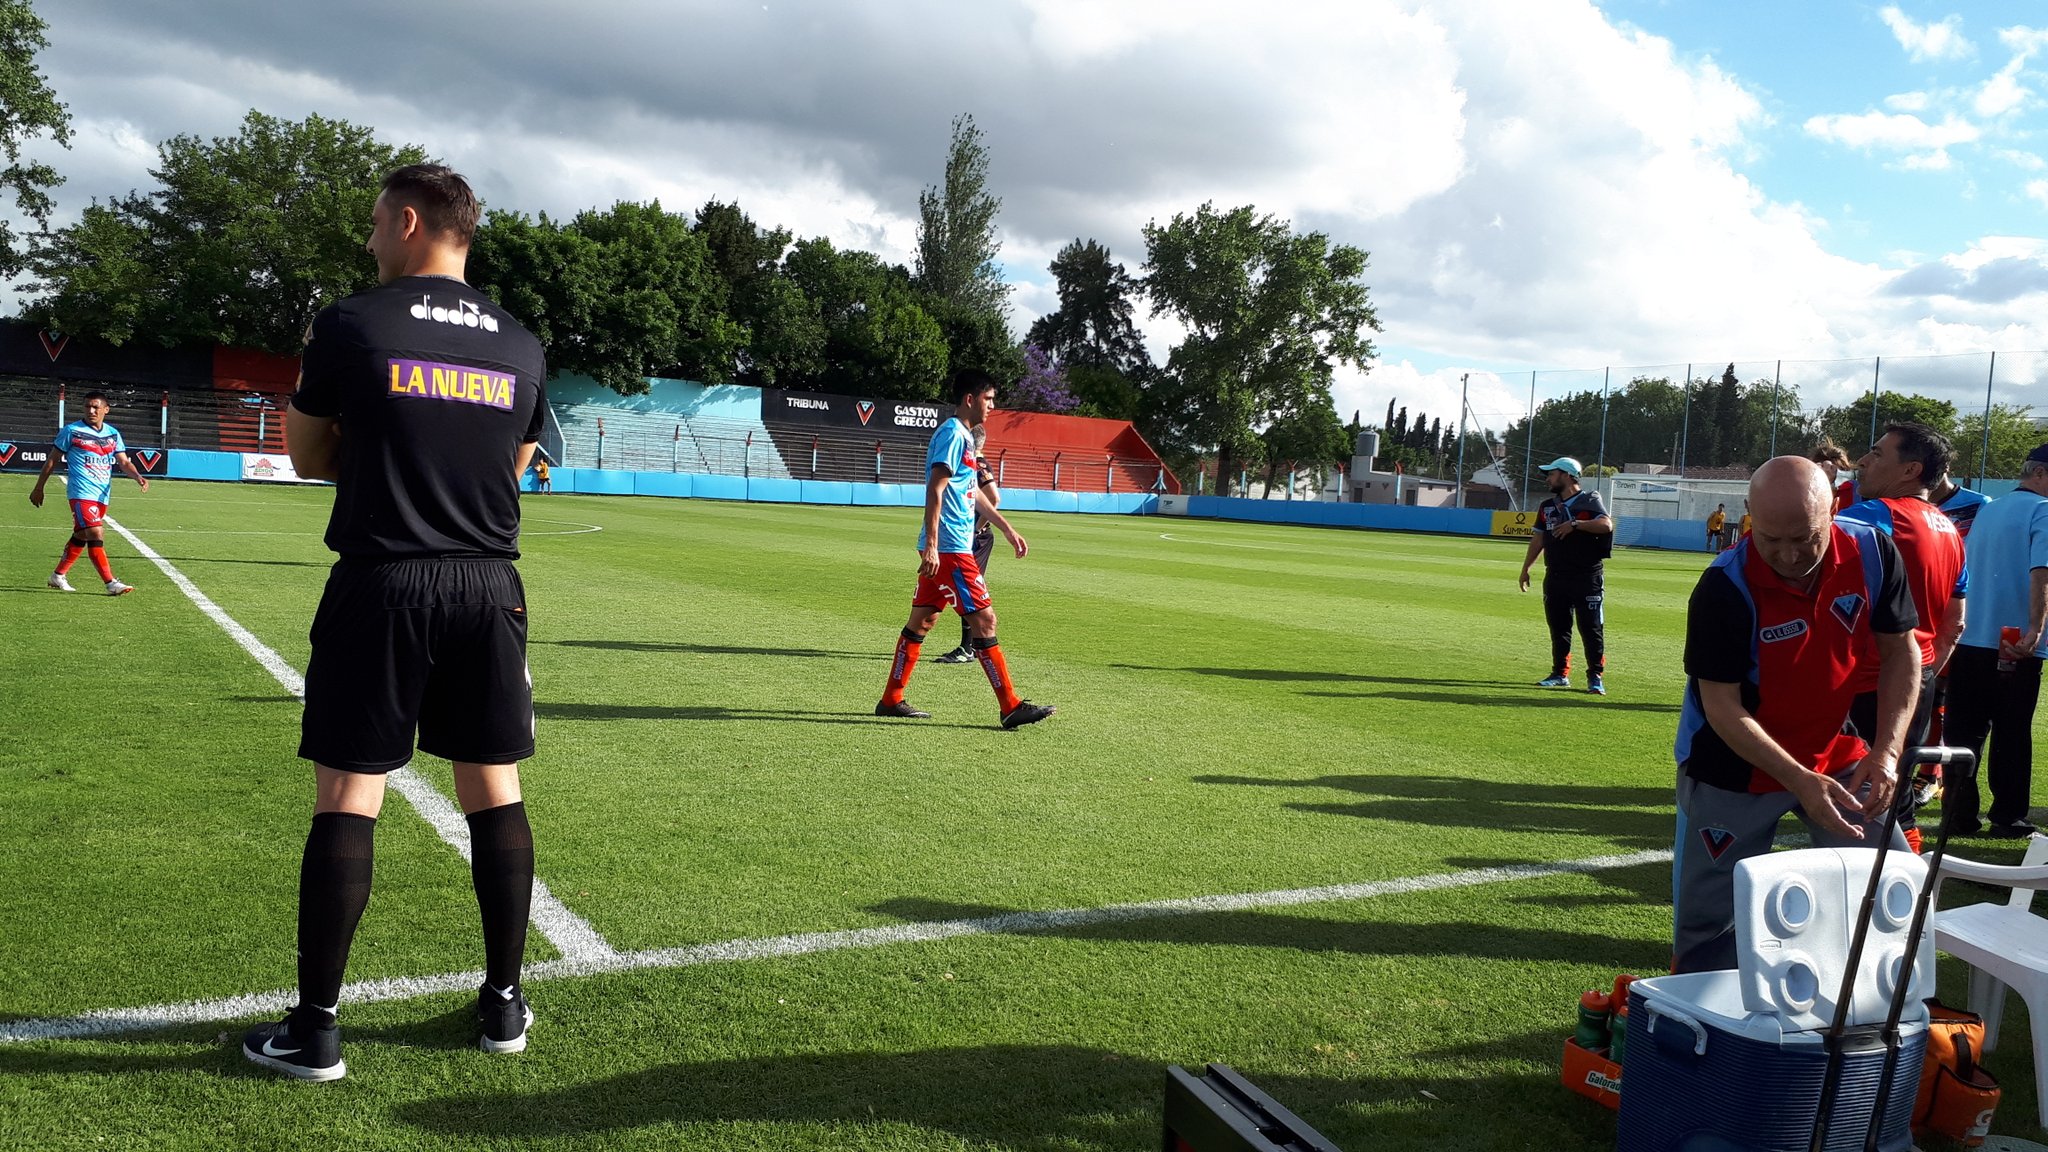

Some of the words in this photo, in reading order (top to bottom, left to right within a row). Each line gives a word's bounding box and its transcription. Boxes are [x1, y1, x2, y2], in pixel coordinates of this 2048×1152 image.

[410, 294, 499, 333] diadora
[391, 364, 427, 395] LA
[432, 367, 511, 406] NUEVA
[786, 397, 829, 411] TRIBUNA
[894, 405, 938, 418] GASTON
[894, 416, 938, 428] GRECCO
[21, 452, 47, 462] CLUB
[1588, 1072, 1622, 1091] Gatorad
